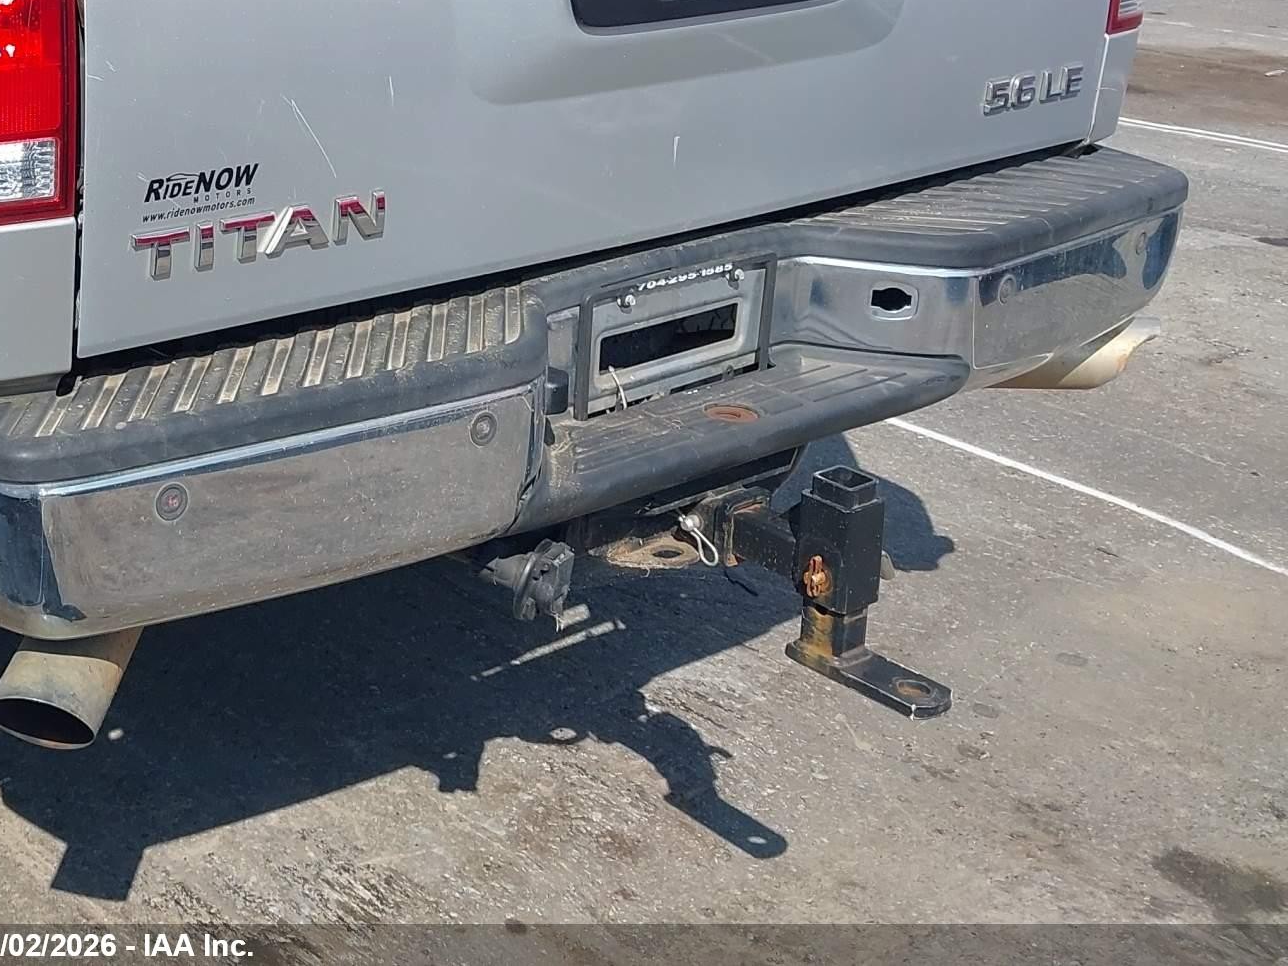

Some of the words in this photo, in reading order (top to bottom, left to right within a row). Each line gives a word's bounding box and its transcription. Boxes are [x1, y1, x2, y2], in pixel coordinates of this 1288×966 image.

[1039, 65, 1083, 104] LE
[142, 197, 256, 223] www.ridenowmotors.com
[193, 187, 252, 204] MOTORS
[129, 188, 387, 281] TITAN
